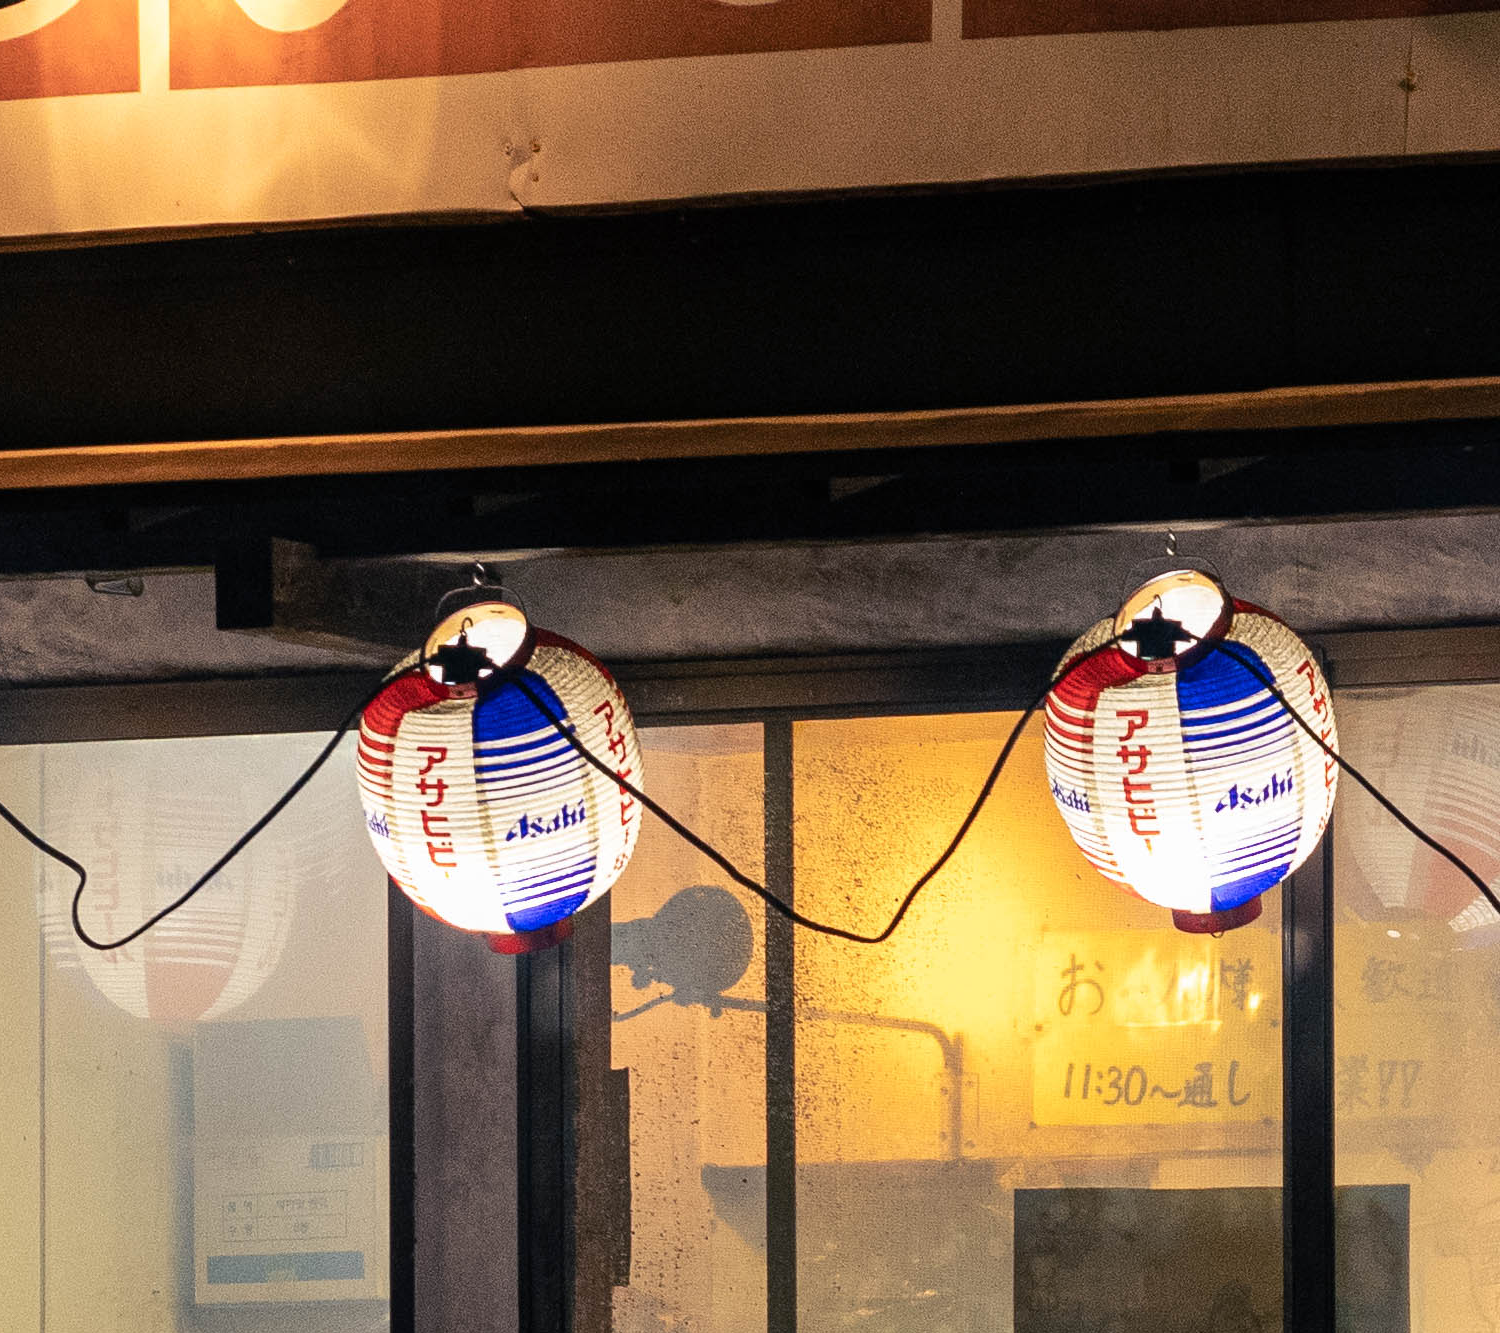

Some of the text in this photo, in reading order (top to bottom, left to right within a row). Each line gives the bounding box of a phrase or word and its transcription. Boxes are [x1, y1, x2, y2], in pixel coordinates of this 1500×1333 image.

[1052, 777, 1091, 813] Asahi
[1215, 768, 1294, 813] Asahi
[505, 799, 588, 842] Asahi
